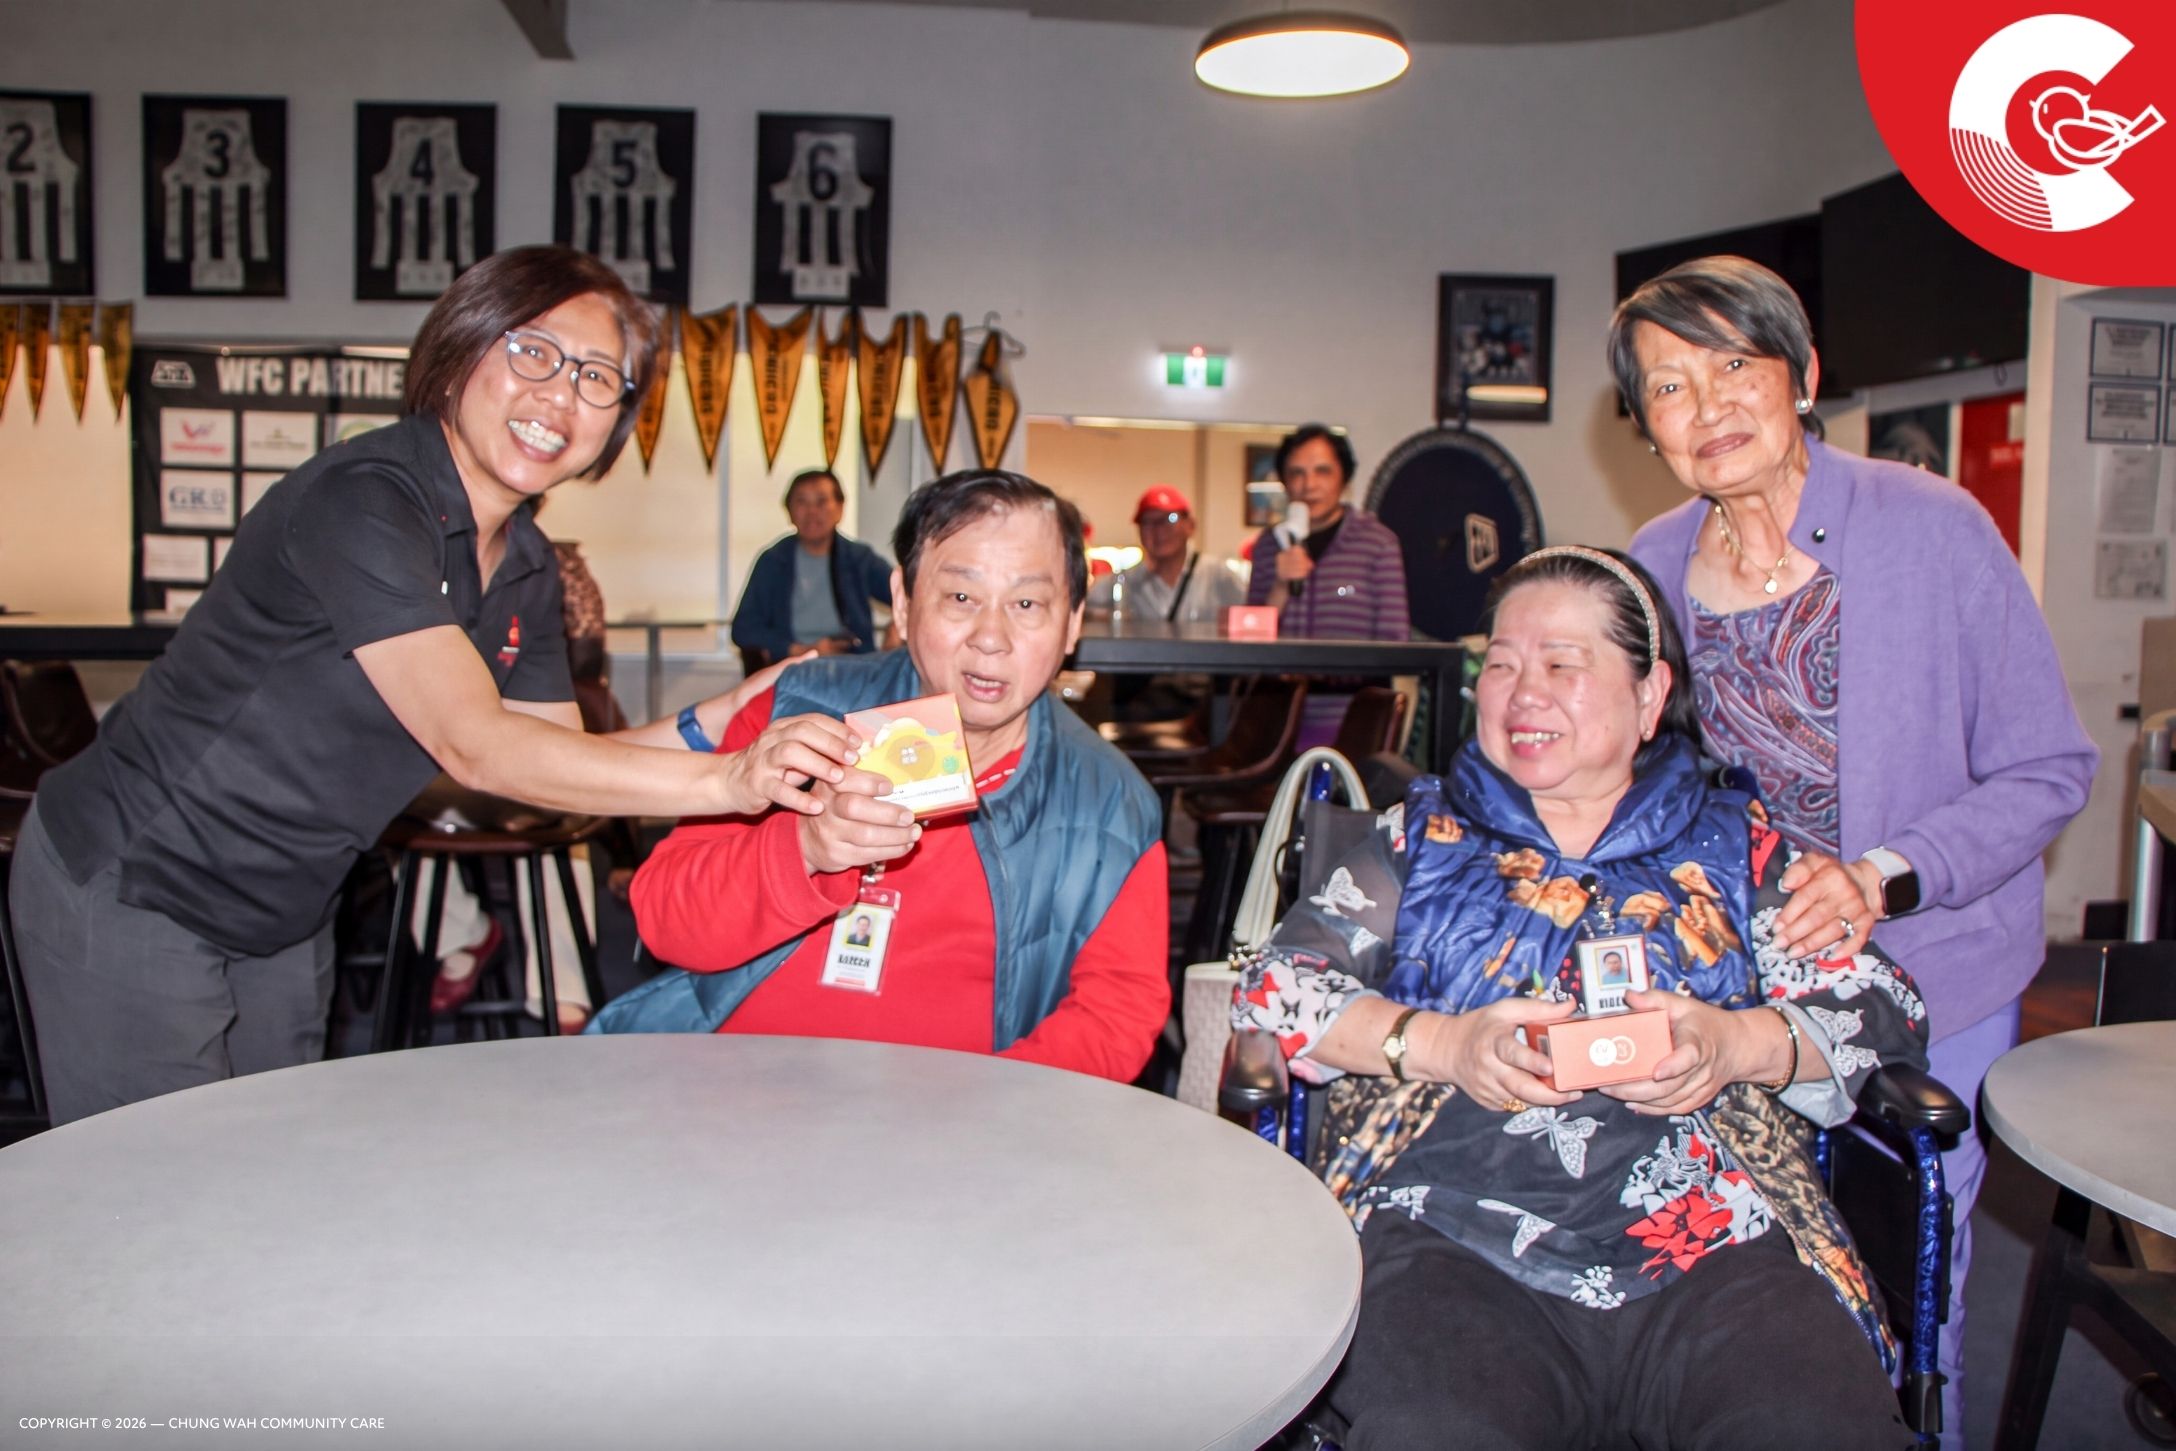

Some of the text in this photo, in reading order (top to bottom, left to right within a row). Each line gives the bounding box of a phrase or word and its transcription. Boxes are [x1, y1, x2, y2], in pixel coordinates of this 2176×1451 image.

[5, 122, 37, 175] 2
[203, 130, 230, 178] 3
[409, 138, 433, 186] 4
[611, 139, 638, 188] 5
[808, 141, 838, 201] 6
[216, 357, 285, 396] WFC
